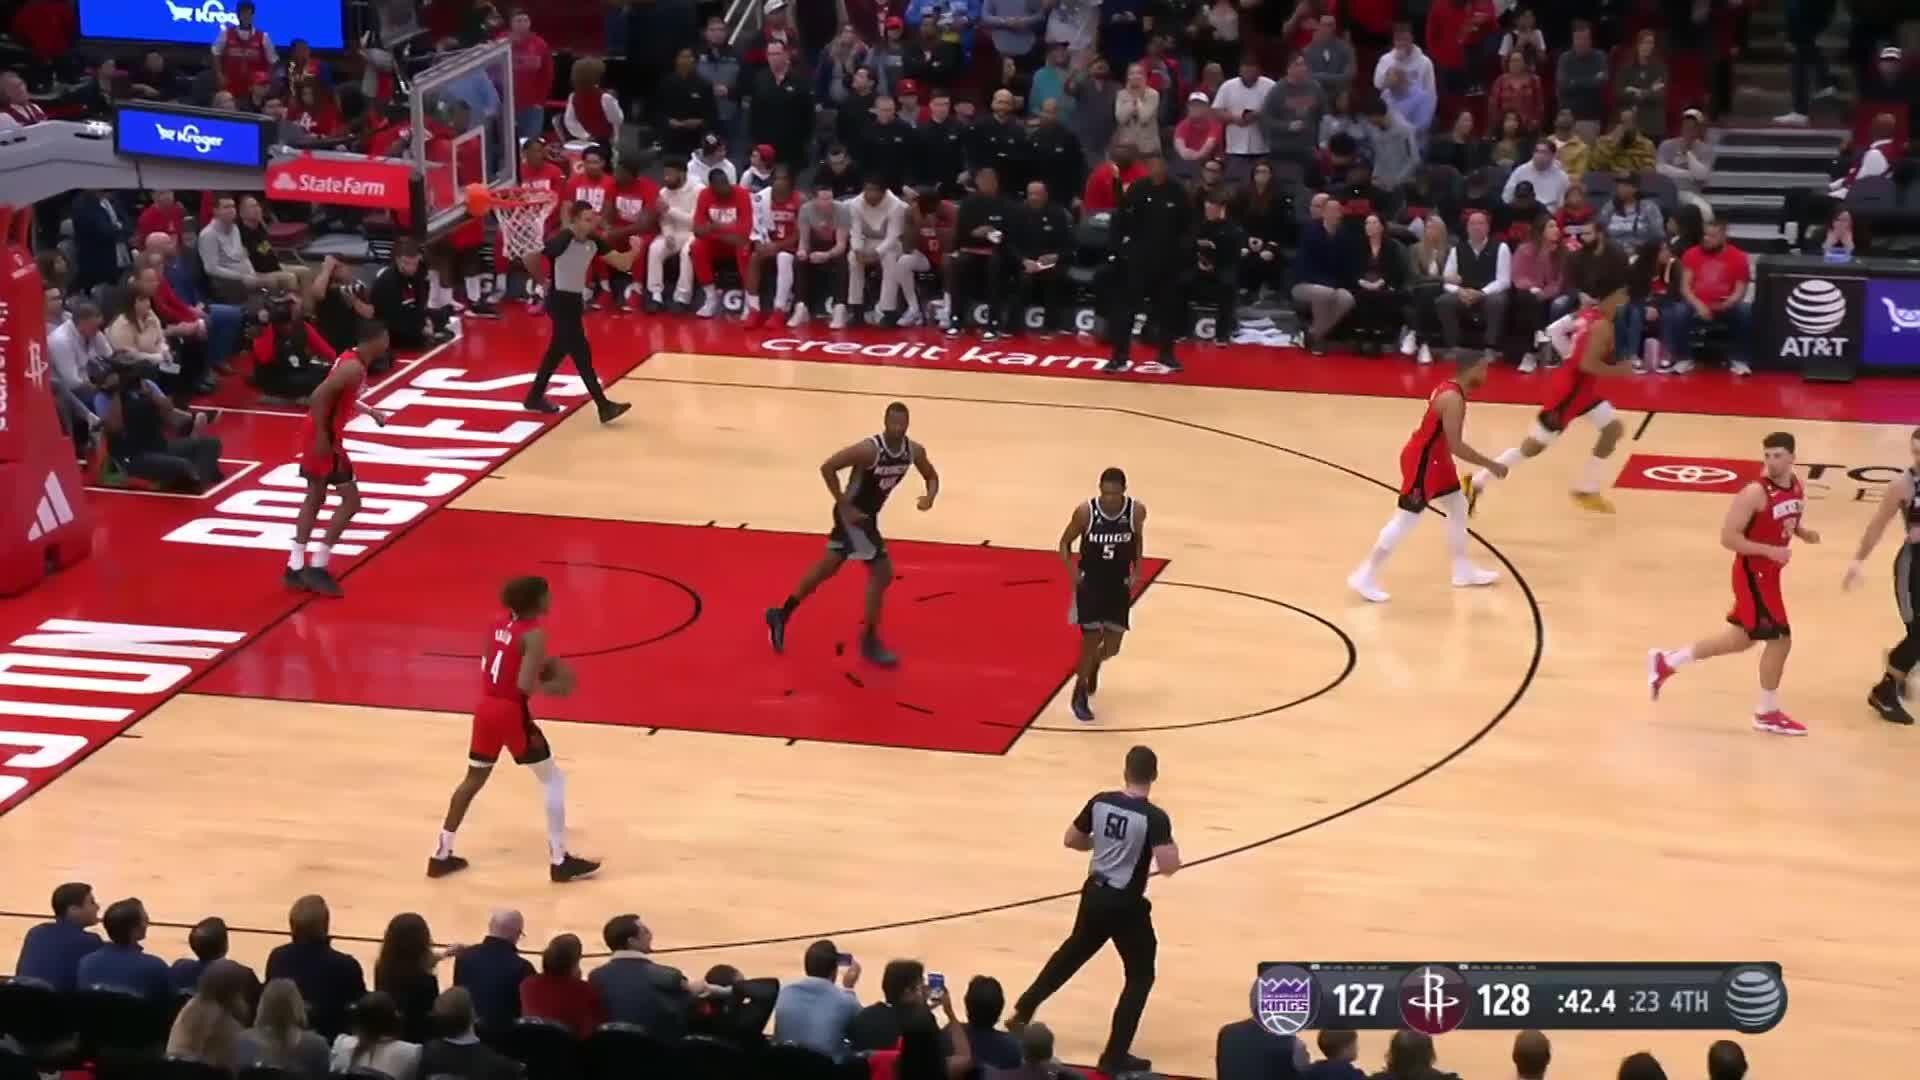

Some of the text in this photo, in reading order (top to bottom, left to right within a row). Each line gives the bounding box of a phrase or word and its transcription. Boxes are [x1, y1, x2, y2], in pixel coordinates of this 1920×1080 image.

[195, 0, 241, 31] Krog
[177, 124, 224, 153] Kroger
[1075, 309, 1095, 331] G
[1194, 318, 1216, 339] G
[761, 338, 949, 361] credit
[1779, 336, 1849, 358] AT&T
[1089, 532, 1132, 543] KINGS
[1102, 544, 1116, 560] 5
[490, 649, 504, 684] 4
[1103, 812, 1129, 841] 50
